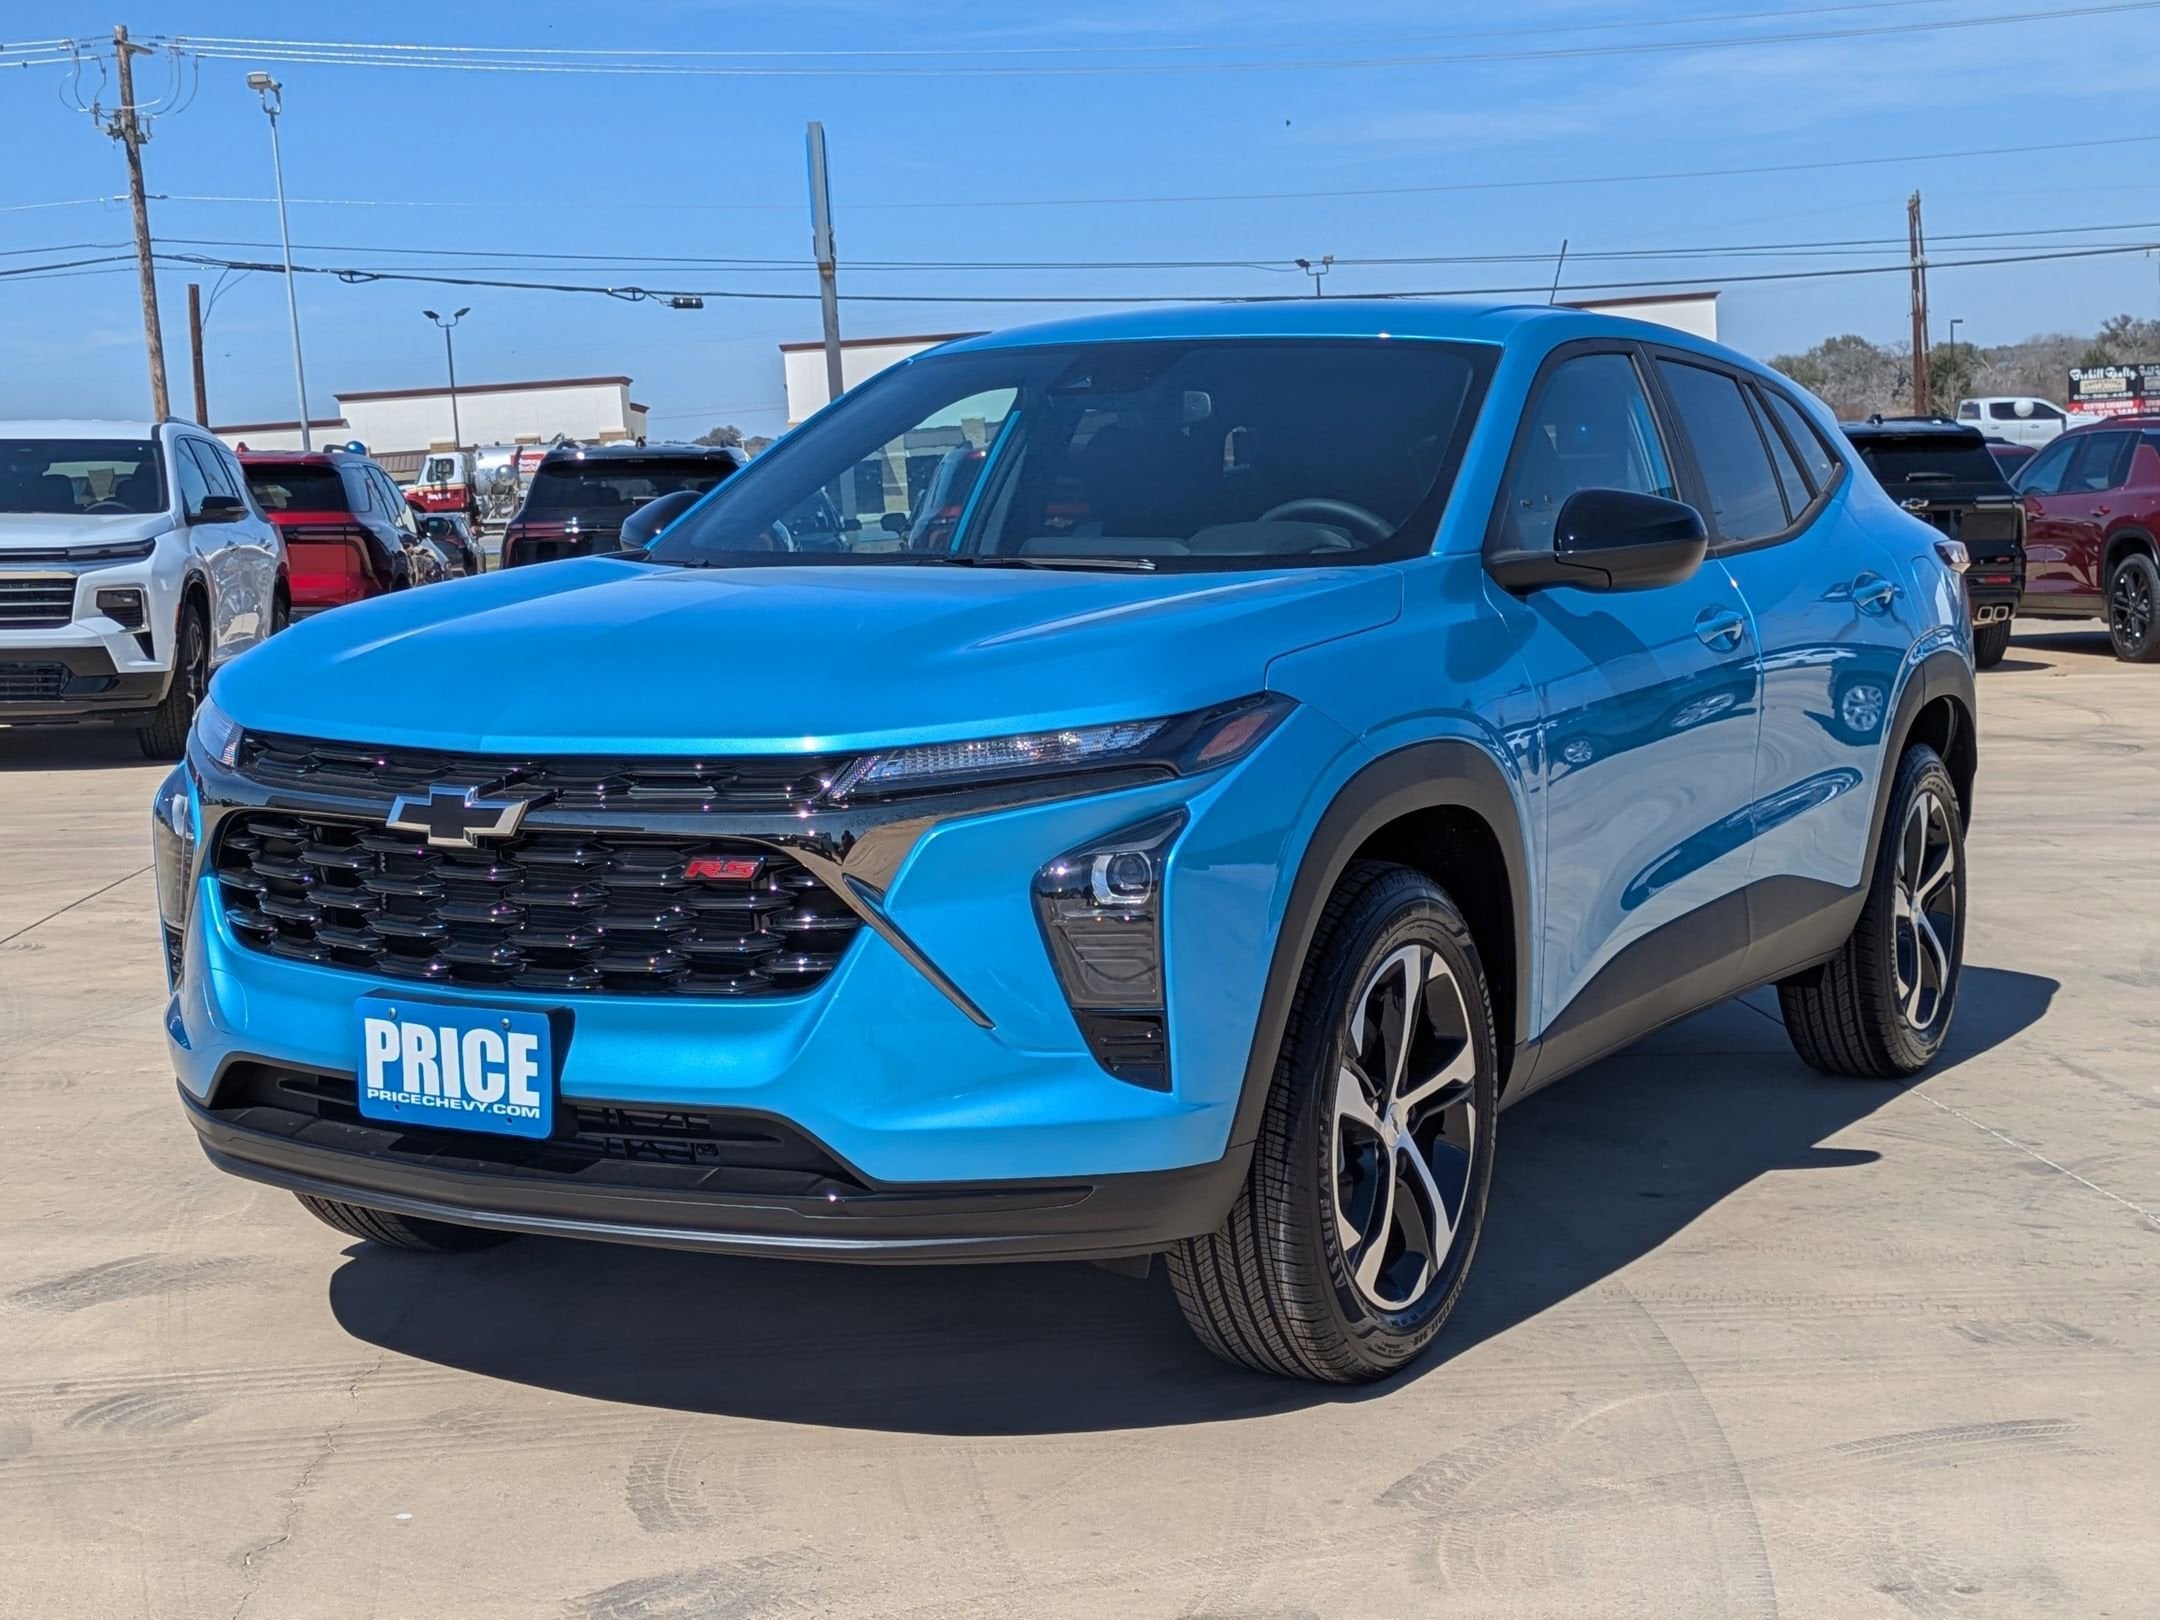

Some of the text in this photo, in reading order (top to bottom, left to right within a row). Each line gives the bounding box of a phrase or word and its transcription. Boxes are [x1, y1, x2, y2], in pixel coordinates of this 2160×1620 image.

[684, 860, 759, 879] RS
[364, 1017, 540, 1107] PRICE
[367, 1087, 541, 1119] PRICECHEVY.COM
